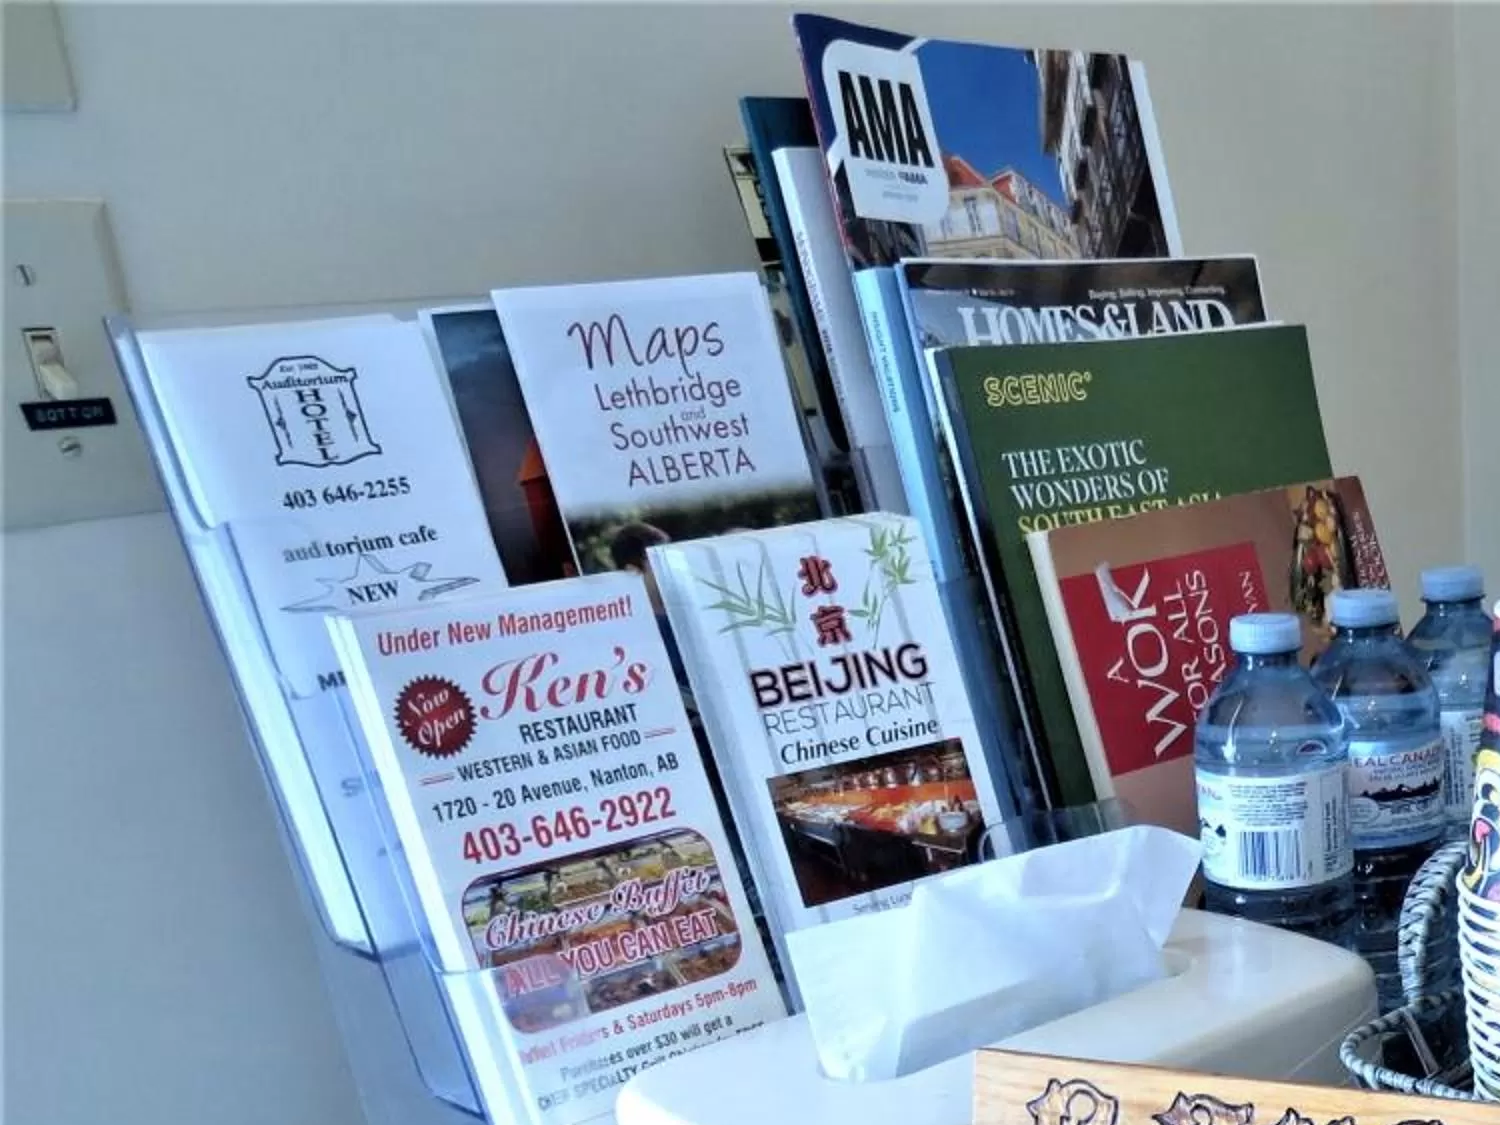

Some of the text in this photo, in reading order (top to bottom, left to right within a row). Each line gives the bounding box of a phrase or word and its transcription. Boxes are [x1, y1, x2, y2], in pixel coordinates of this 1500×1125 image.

[838, 70, 934, 168] AMA
[567, 313, 725, 378] Maps
[262, 374, 349, 390] Auditorium
[594, 371, 743, 412] Lethbridge
[983, 370, 1088, 407] SCENIC
[296, 388, 340, 460] HOTEL
[611, 412, 750, 450] Southwest
[680, 407, 707, 420] and
[628, 447, 757, 488] ALBERTA
[1001, 439, 1146, 480] THE EXOTIC
[282, 475, 412, 511] 403 646-2255
[1008, 467, 1169, 511] WONDERS OF
[282, 525, 439, 563] audtorium cafe
[346, 579, 399, 605] NEW
[797, 555, 853, 647] 北京
[1163, 577, 1195, 643] ALL
[377, 595, 633, 657] Under New Management!
[480, 646, 648, 720] Ken's
[749, 642, 930, 709] BEIJING
[1094, 562, 1188, 757] WOK
[1106, 656, 1130, 683] A
[417, 707, 467, 748] Open
[519, 703, 639, 744] RESTAURANT
[762, 682, 937, 737] RESTAURANT
[457, 729, 642, 783] WESTERN & ASIAN FOOD
[780, 715, 940, 766] Chinese Cuisine
[432, 797, 478, 824] 1720
[493, 788, 518, 810] 20
[521, 773, 589, 802] Avenue,
[589, 760, 654, 791] Nanton,
[657, 751, 680, 772] AB
[462, 786, 677, 864] 403-646-2922
[485, 866, 711, 950] Chinese Buffet
[507, 908, 720, 996] ALL YOU CAN EAT
[612, 1019, 625, 1035] &
[627, 998, 694, 1031] Saturdays
[626, 1042, 652, 1060] over
[655, 1032, 679, 1050] $30
[680, 1024, 702, 1042] will
[703, 1017, 724, 1036] get
[724, 1015, 734, 1028] a
